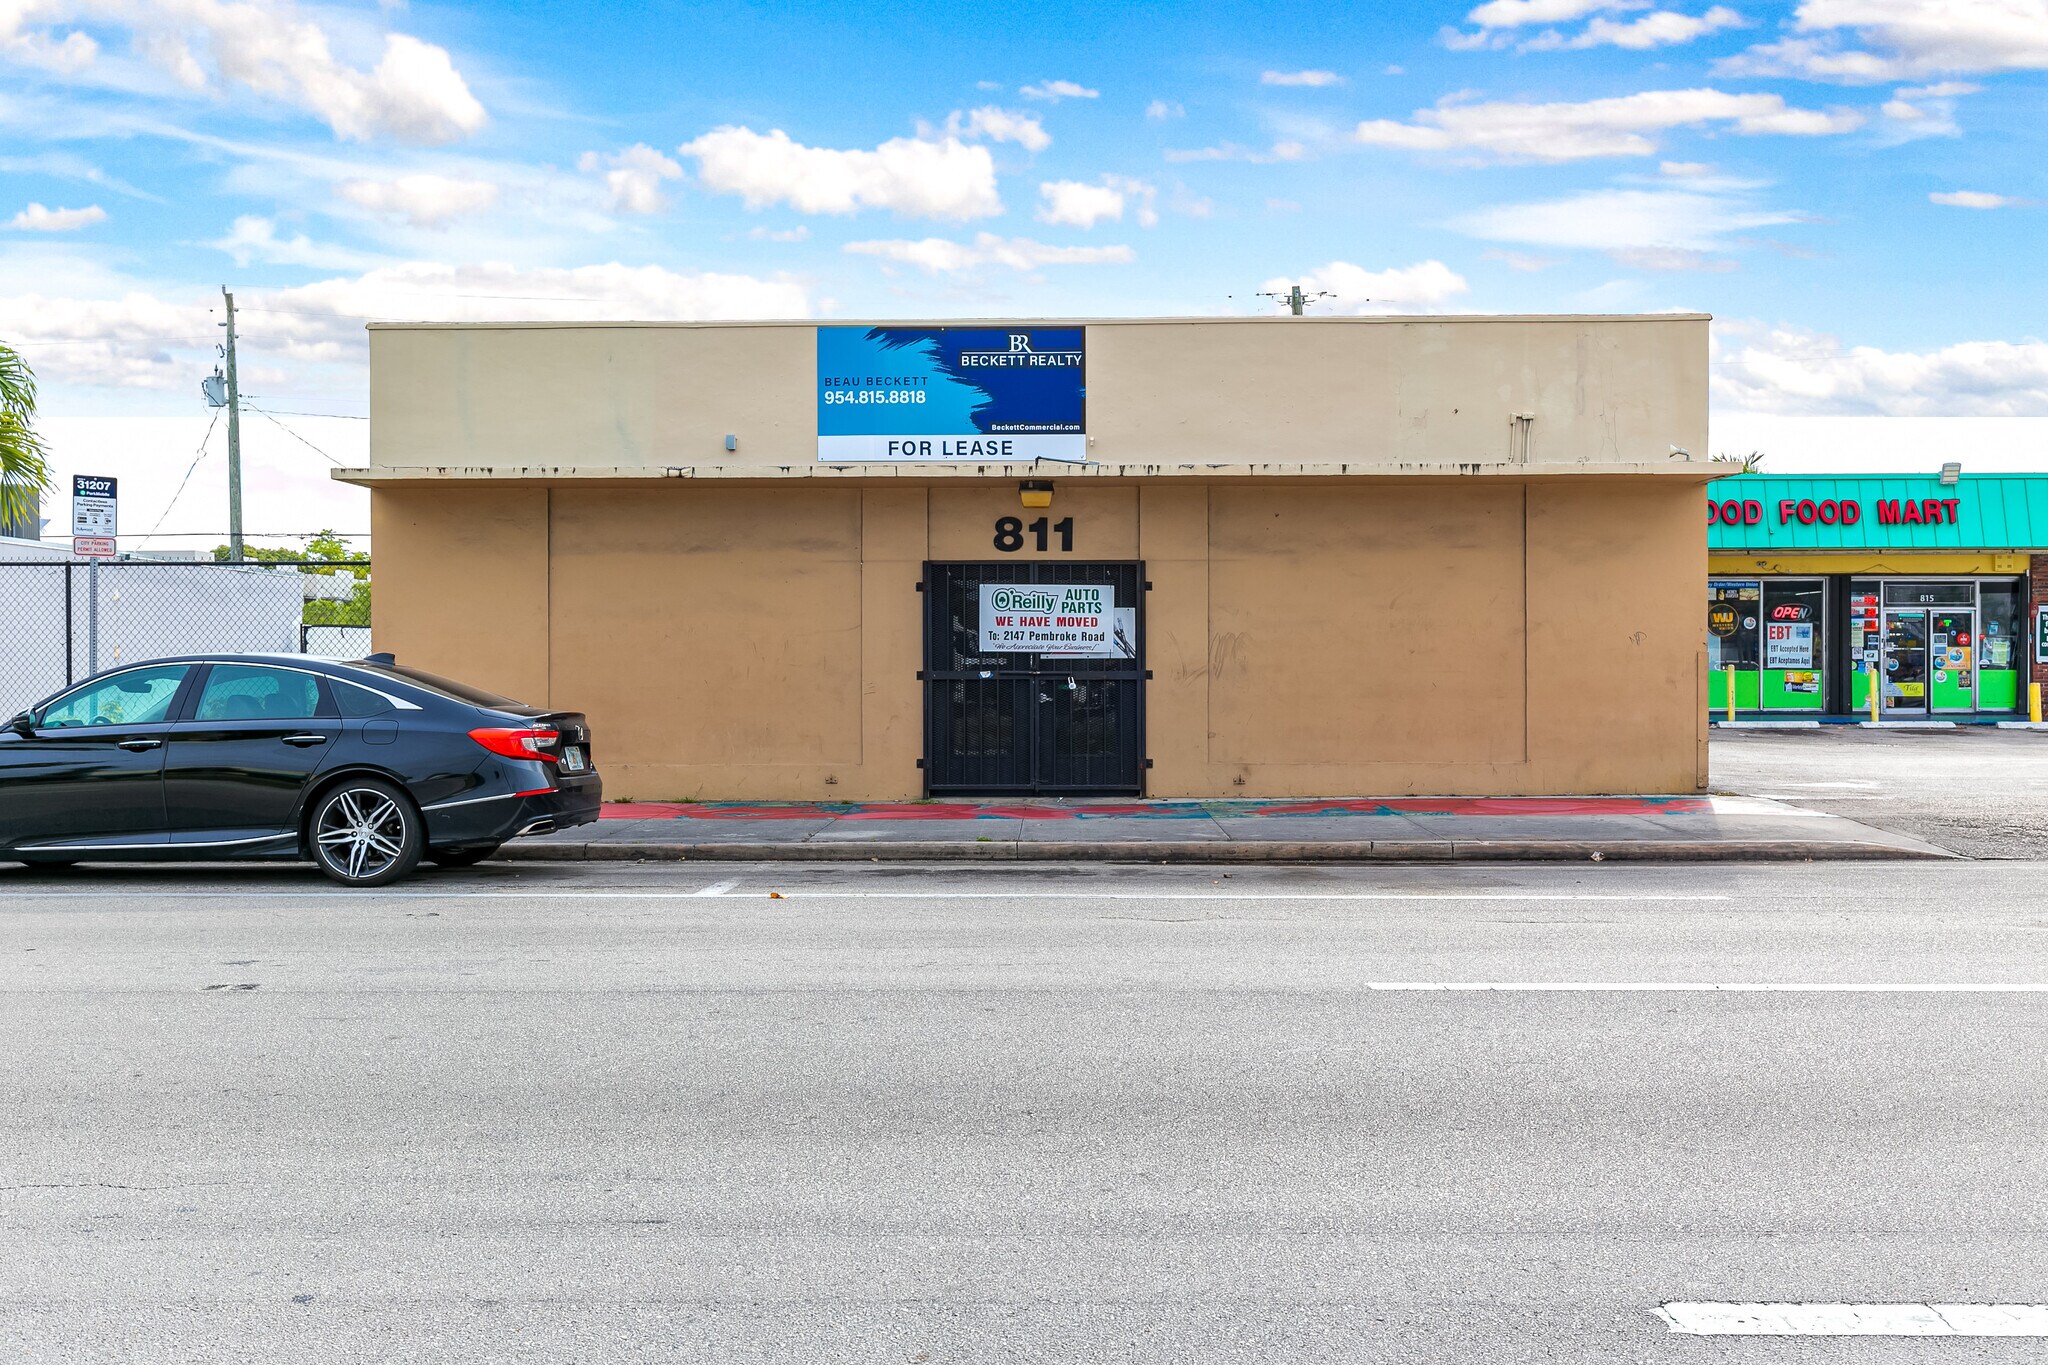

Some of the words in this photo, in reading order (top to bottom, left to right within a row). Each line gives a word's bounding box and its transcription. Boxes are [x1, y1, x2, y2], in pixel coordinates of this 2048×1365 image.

[961, 355, 1026, 366] BECKETT
[1029, 355, 1082, 366] REALTY
[824, 377, 860, 387] BEAU
[866, 376, 929, 386] BECKETT
[824, 390, 926, 405] 954.815.8818
[991, 423, 1080, 431] BeckettCommercial.com
[888, 440, 932, 456] FOR
[942, 440, 1013, 456] LEASE
[77, 480, 111, 490] 31207
[1779, 499, 1860, 525] FOOD
[1877, 499, 1960, 525] MART
[993, 516, 1073, 552] 811
[993, 589, 1057, 613] O'Reilly
[1065, 589, 1100, 601] AUTO
[1061, 602, 1102, 614] PARTS
[1773, 606, 1808, 619] OPEN
[996, 616, 1014, 627] WE
[1020, 616, 1051, 627] HAVE
[1056, 616, 1098, 627] MOVED
[988, 631, 1000, 641] To:
[1003, 631, 1025, 641] 2147
[1029, 631, 1077, 641] Pembroke
[1081, 632, 1105, 642] Road
[1769, 626, 1792, 640] EBT
[1770, 645, 1778, 653] EBT
[1780, 645, 1798, 653] Accepted
[1778, 657, 1800, 666] Aceptamos
